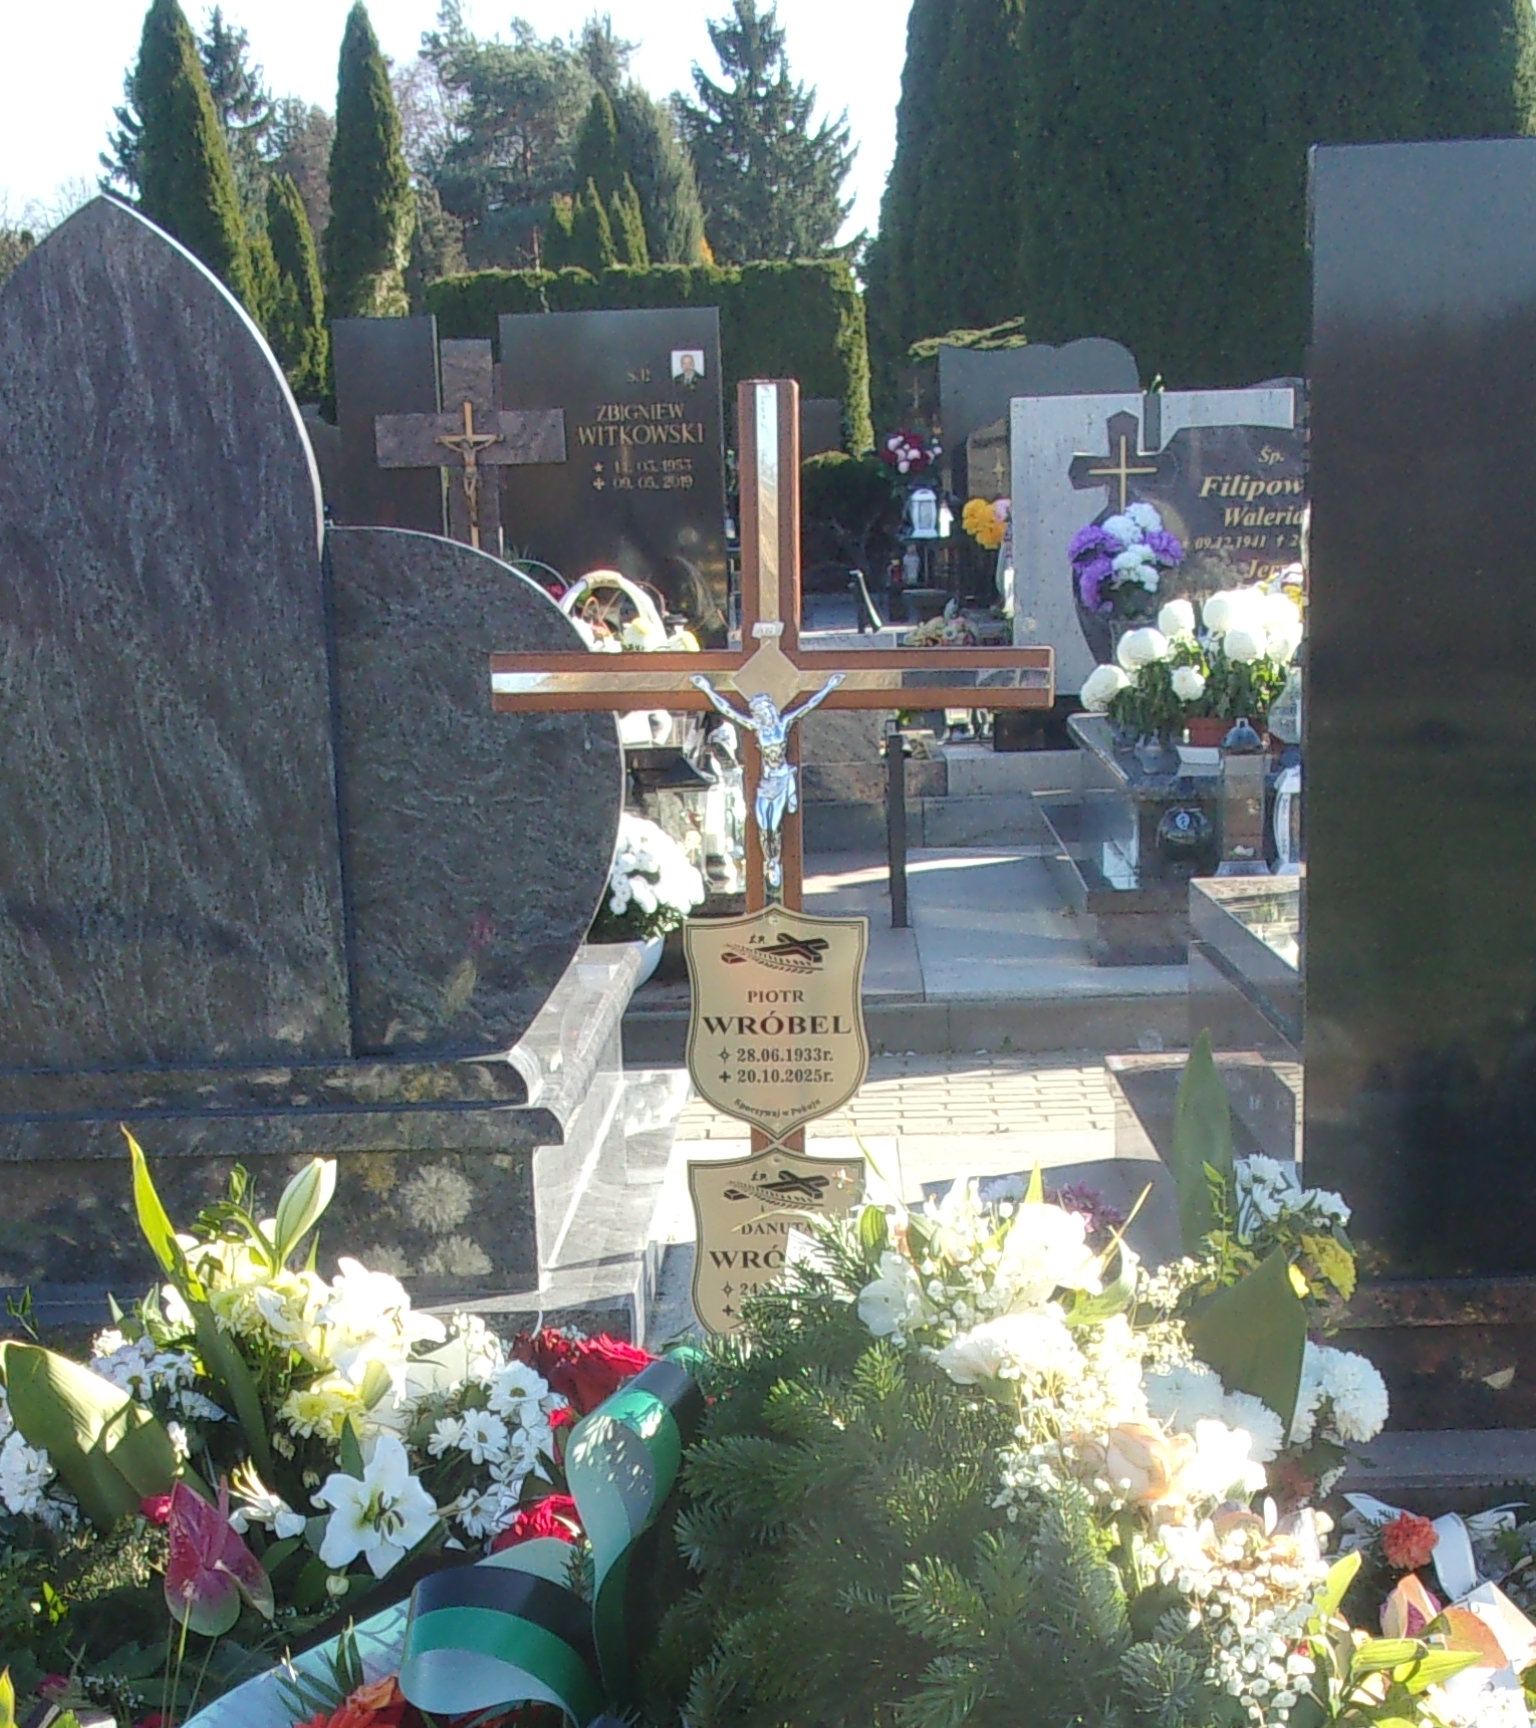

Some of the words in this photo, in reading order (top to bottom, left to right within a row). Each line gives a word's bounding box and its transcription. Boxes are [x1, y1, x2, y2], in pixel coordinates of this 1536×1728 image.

[596, 403, 684, 422] ZBIGNIEW
[578, 423, 704, 446] WITKOWSKI
[1198, 474, 1305, 502] Filipow
[747, 989, 805, 1003] PIOTR
[702, 1009, 852, 1036] WRÓBEL
[736, 1047, 834, 1063] 28.06.1933r.
[740, 1221, 814, 1236] DANUTA
[709, 1244, 786, 1270] WRÓ
